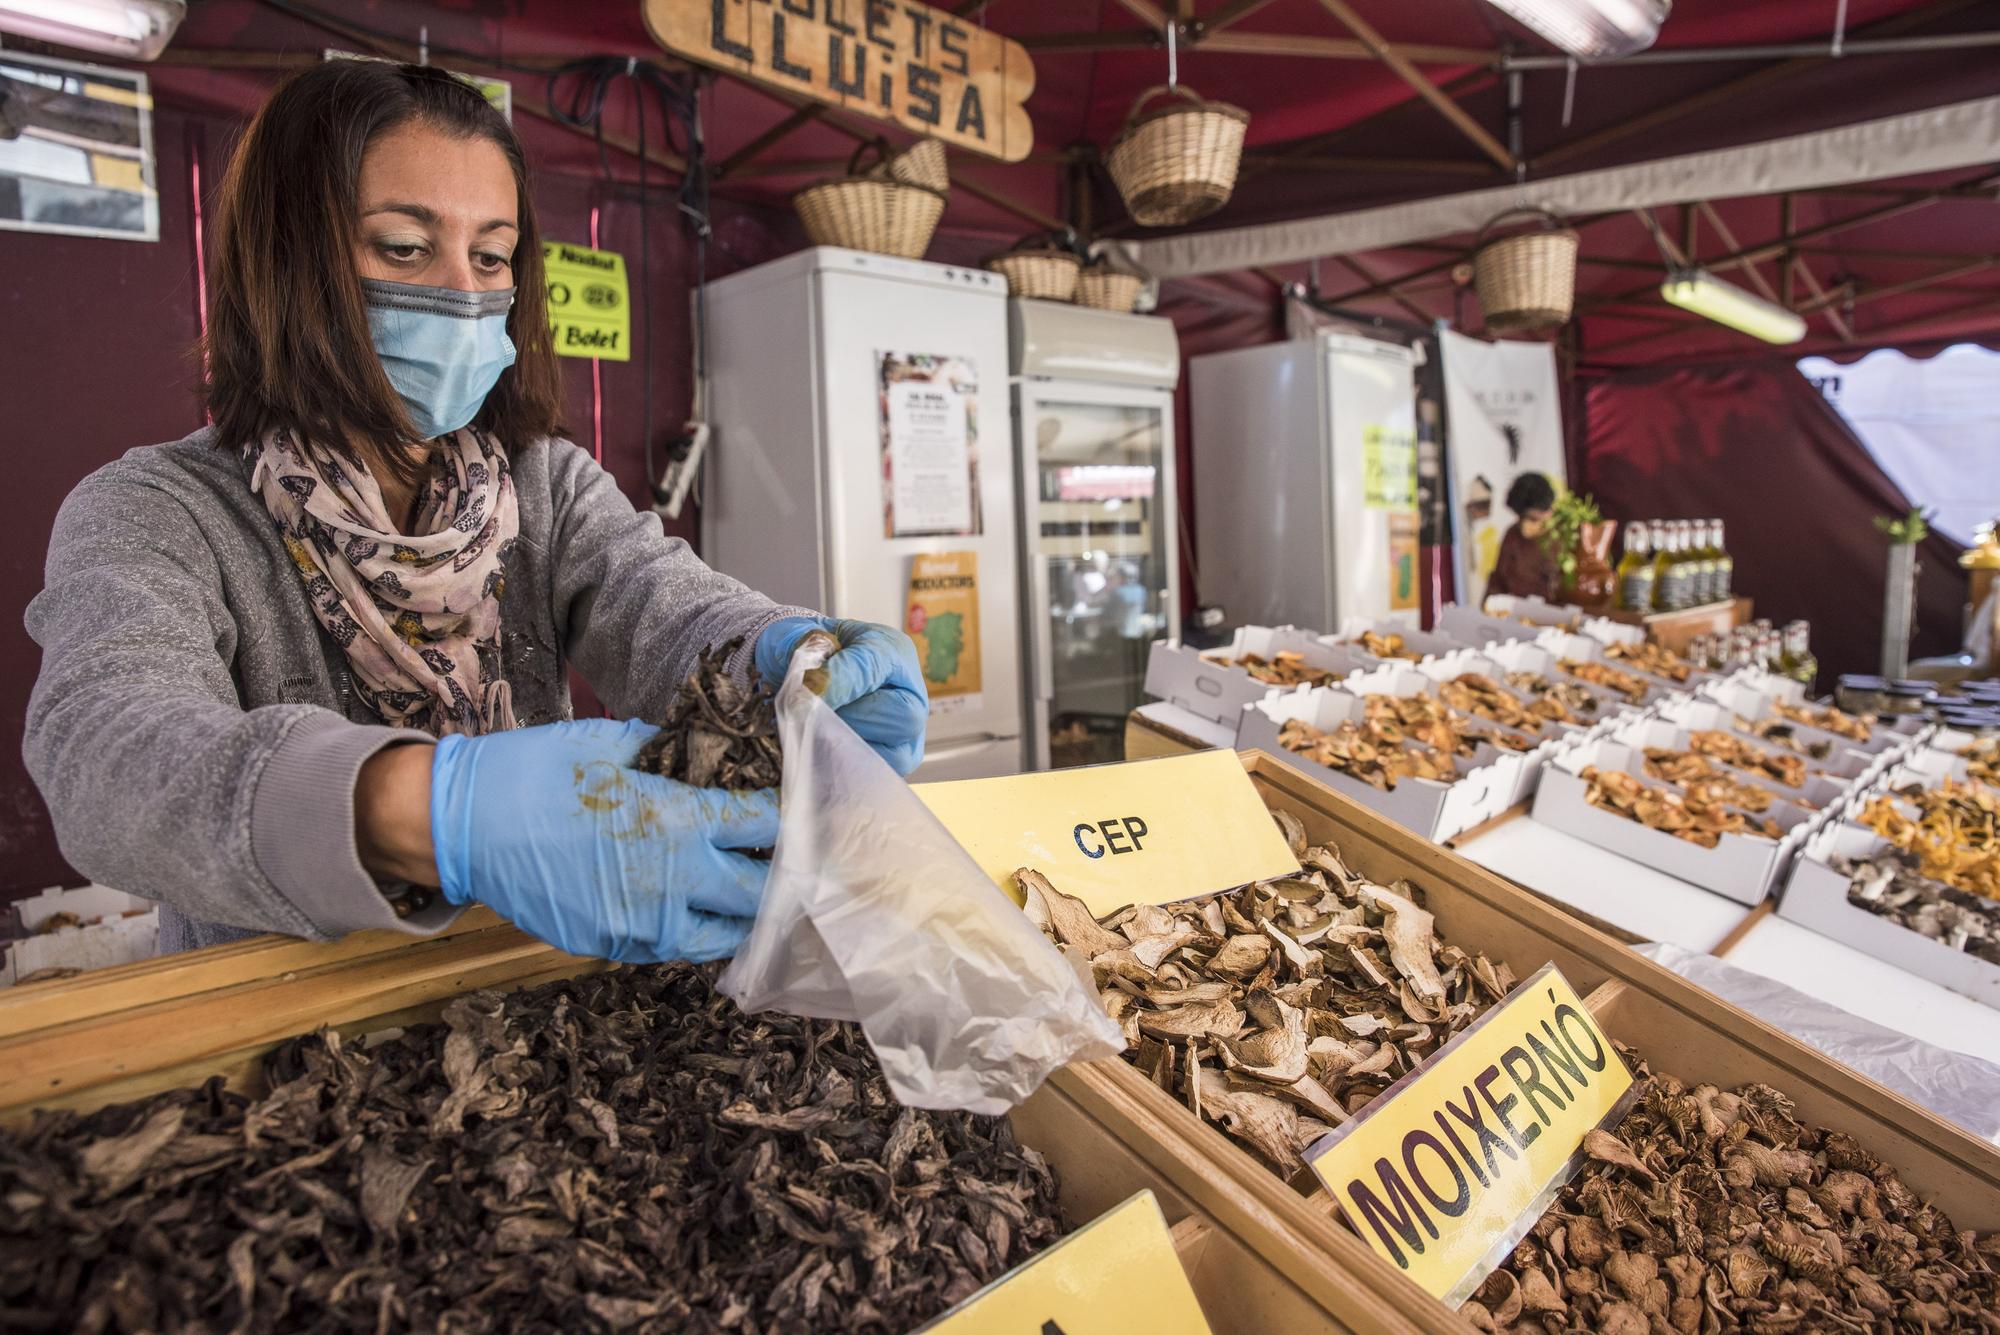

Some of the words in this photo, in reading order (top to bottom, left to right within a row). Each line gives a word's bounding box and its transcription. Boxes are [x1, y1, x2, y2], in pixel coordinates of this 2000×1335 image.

[735, 0, 969, 77] LETS
[566, 325, 618, 349] Bolet
[1073, 816, 1148, 859] CEP
[1346, 987, 1606, 1271] MOIXERNÓ
